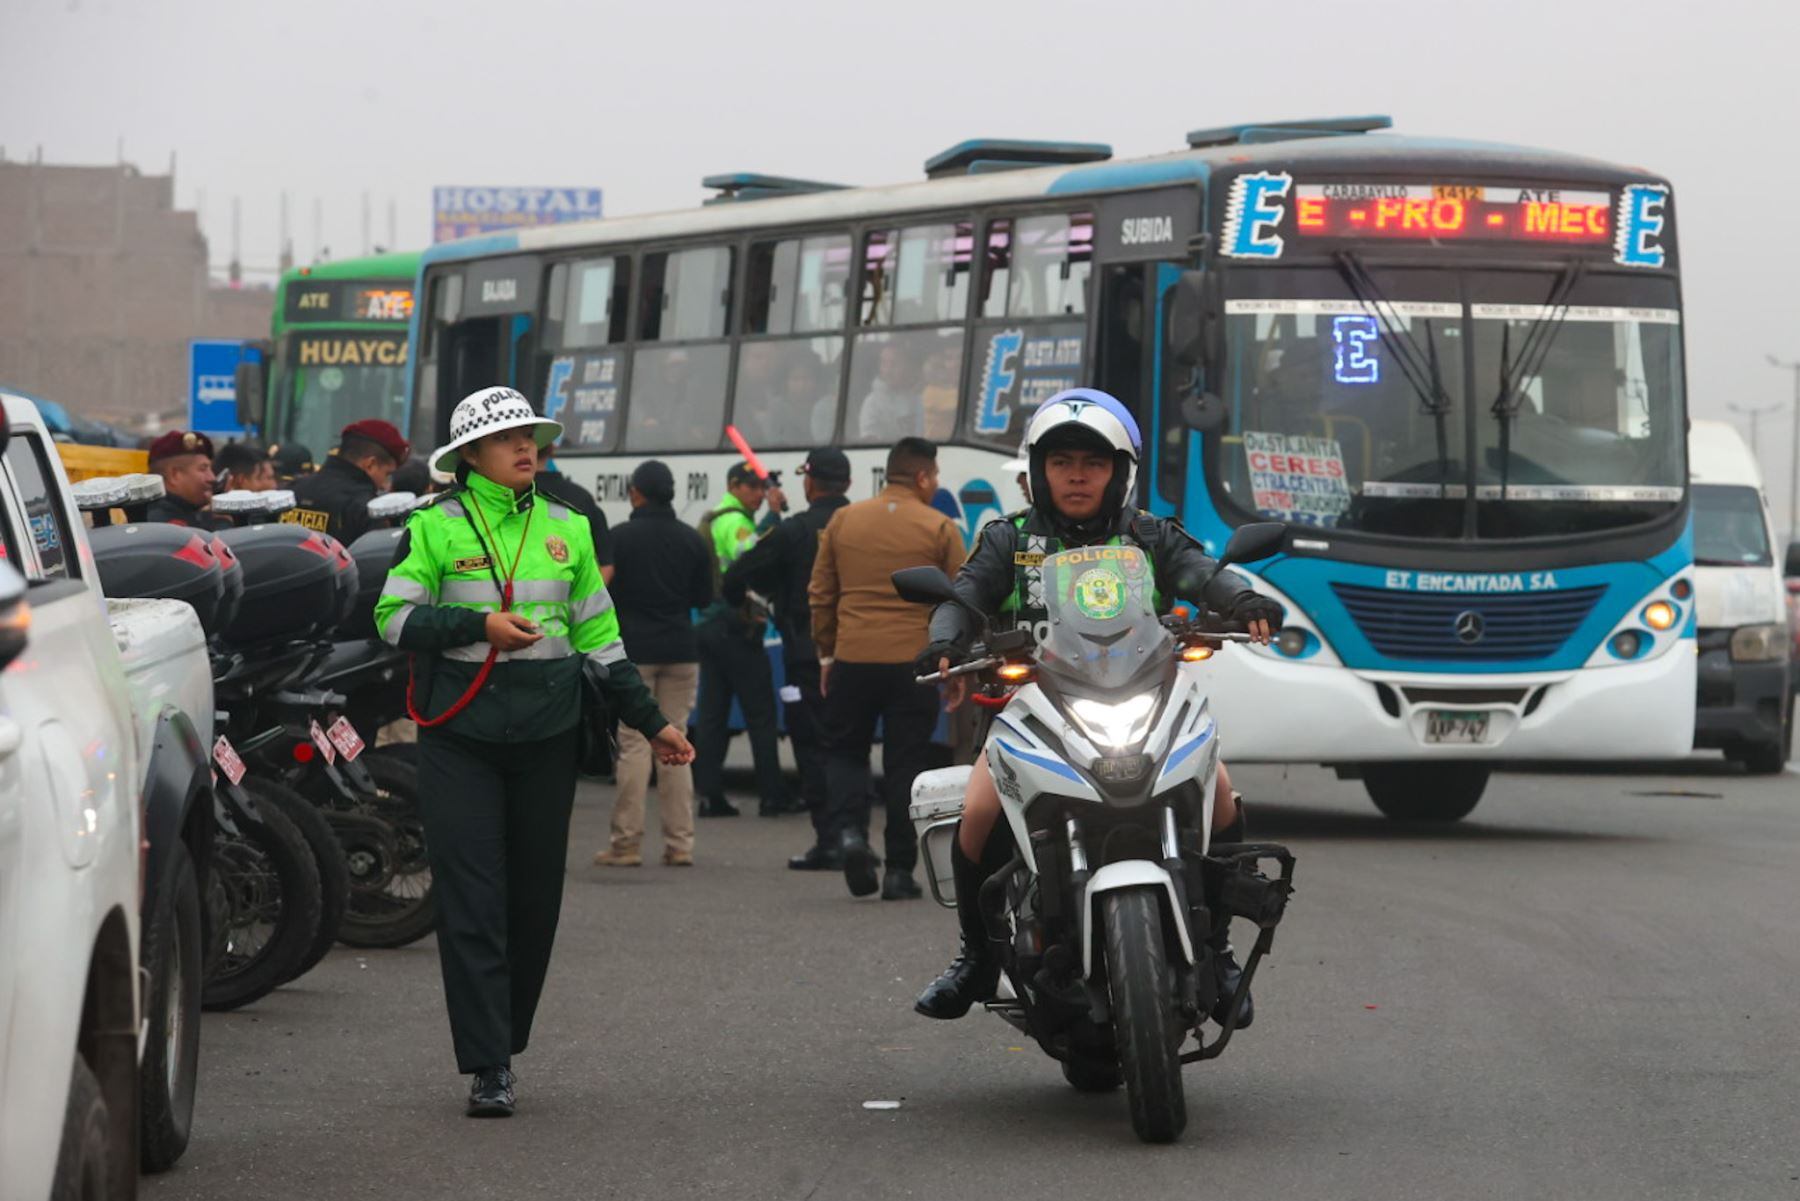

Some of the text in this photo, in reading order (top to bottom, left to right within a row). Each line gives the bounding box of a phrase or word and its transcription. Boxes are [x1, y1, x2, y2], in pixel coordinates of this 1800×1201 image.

[436, 189, 599, 212] HOSTAL
[1322, 185, 1408, 200] CARABAYLLO
[1436, 185, 1481, 200] 1412
[1518, 190, 1561, 204] ATE
[1218, 171, 1292, 258] E
[1375, 197, 1464, 230] PRO
[1613, 184, 1669, 267] E
[1121, 216, 1174, 244] SUBIDA
[299, 292, 330, 309] ATE
[366, 294, 406, 319] ATE
[1333, 315, 1379, 383] E
[1249, 452, 1343, 478] CERES
[1056, 548, 1138, 567] POLICIA
[1417, 573, 1524, 592] ENCANTADA
